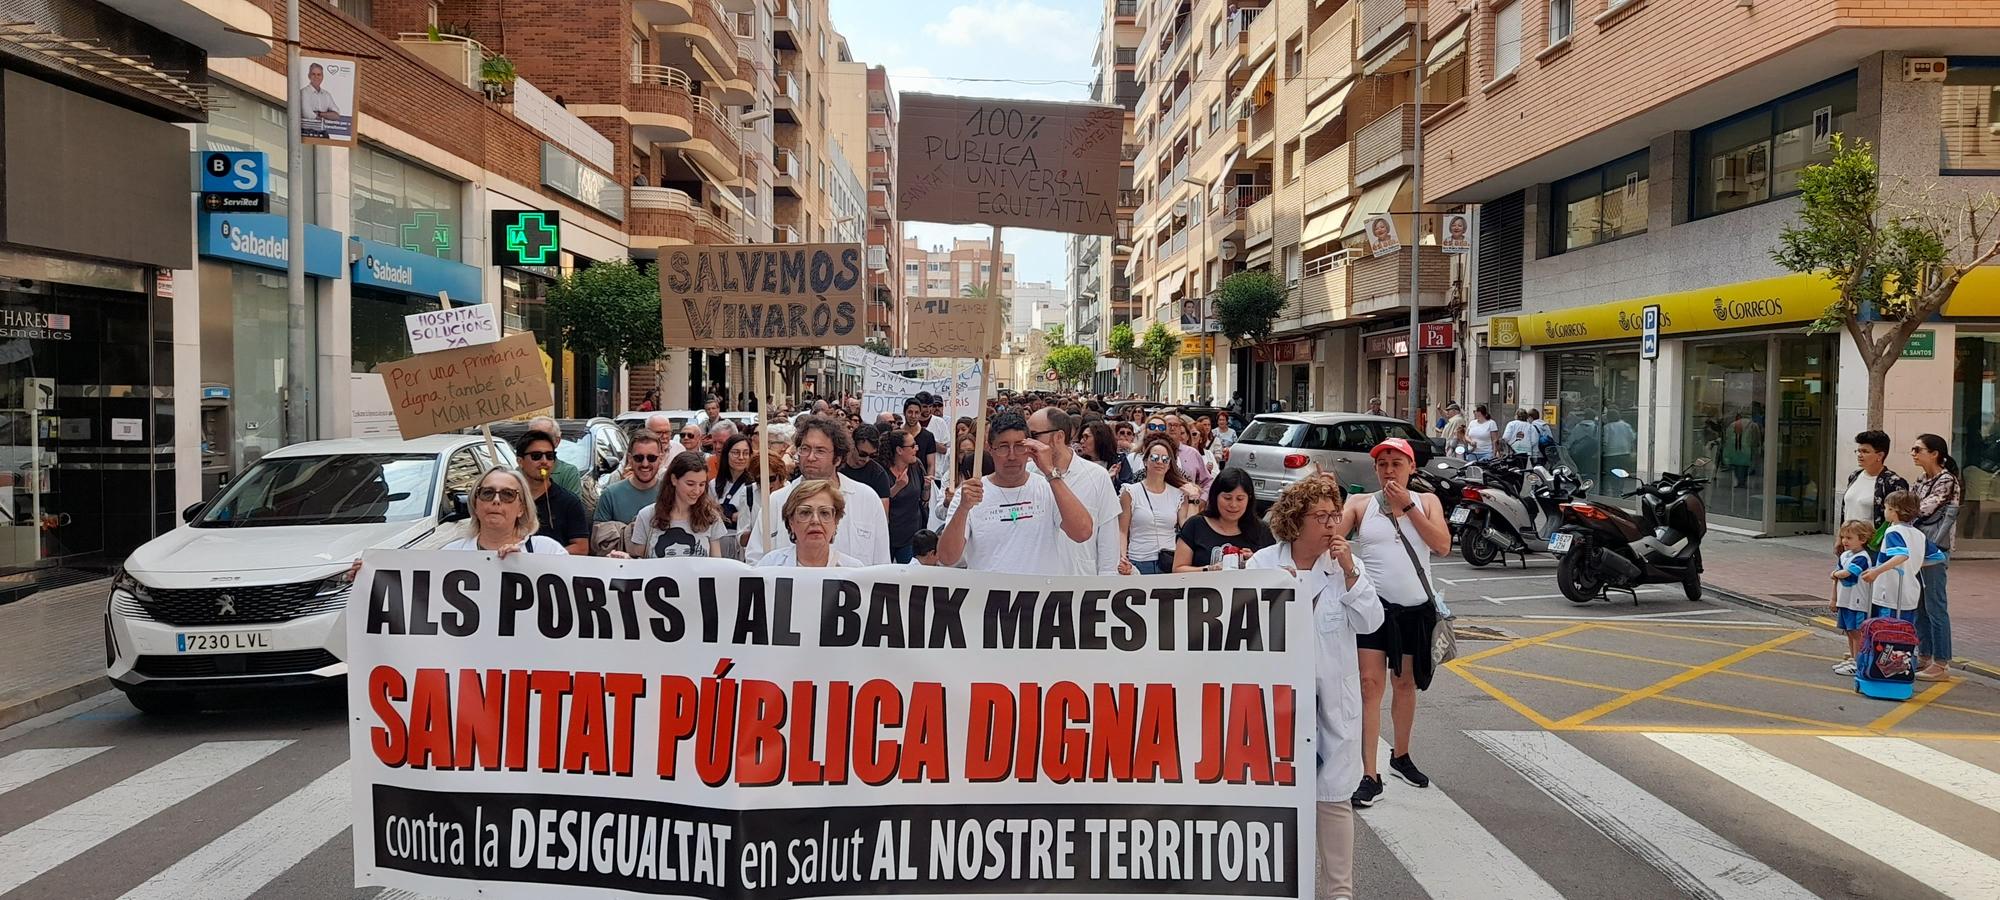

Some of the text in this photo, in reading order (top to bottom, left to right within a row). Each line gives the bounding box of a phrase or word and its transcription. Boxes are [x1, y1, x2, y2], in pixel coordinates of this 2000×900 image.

[966, 107, 1046, 142] 100%
[213, 159, 225, 172] B
[233, 158, 258, 190] S
[966, 166, 1101, 197] UNIVERSAL
[223, 197, 259, 207] ServiRed
[977, 191, 1114, 225] EQUITATIVA
[230, 226, 289, 261] Sabadell
[372, 259, 413, 286] Sabadell
[668, 249, 860, 295] SALVEMOS
[418, 307, 485, 327] HOSPITAL
[682, 294, 856, 341] VINARÒS
[925, 299, 949, 314] TU
[1728, 297, 1783, 321] CORREOS
[411, 319, 493, 342] SOLUCIONS
[1553, 321, 1588, 339] CORREOS
[1629, 311, 1672, 330] COOS
[1647, 312, 1654, 328] P
[446, 336, 470, 347] YA
[1427, 330, 1445, 346] Pa
[390, 367, 422, 390] Per
[429, 366, 457, 382] una
[504, 366, 526, 387] al
[876, 381, 894, 392] PER
[477, 391, 537, 419] RURAL
[366, 569, 1295, 653] ALS PORTS I AL BAIX MAESTRAT
[187, 633, 268, 650] 7230 LVL
[368, 657, 1297, 788] SANITAT PÚBLICA DIGNA JA!
[385, 805, 1285, 890] contra la DESIGUALTAT en salut AL NOSTRE TERRITORI
